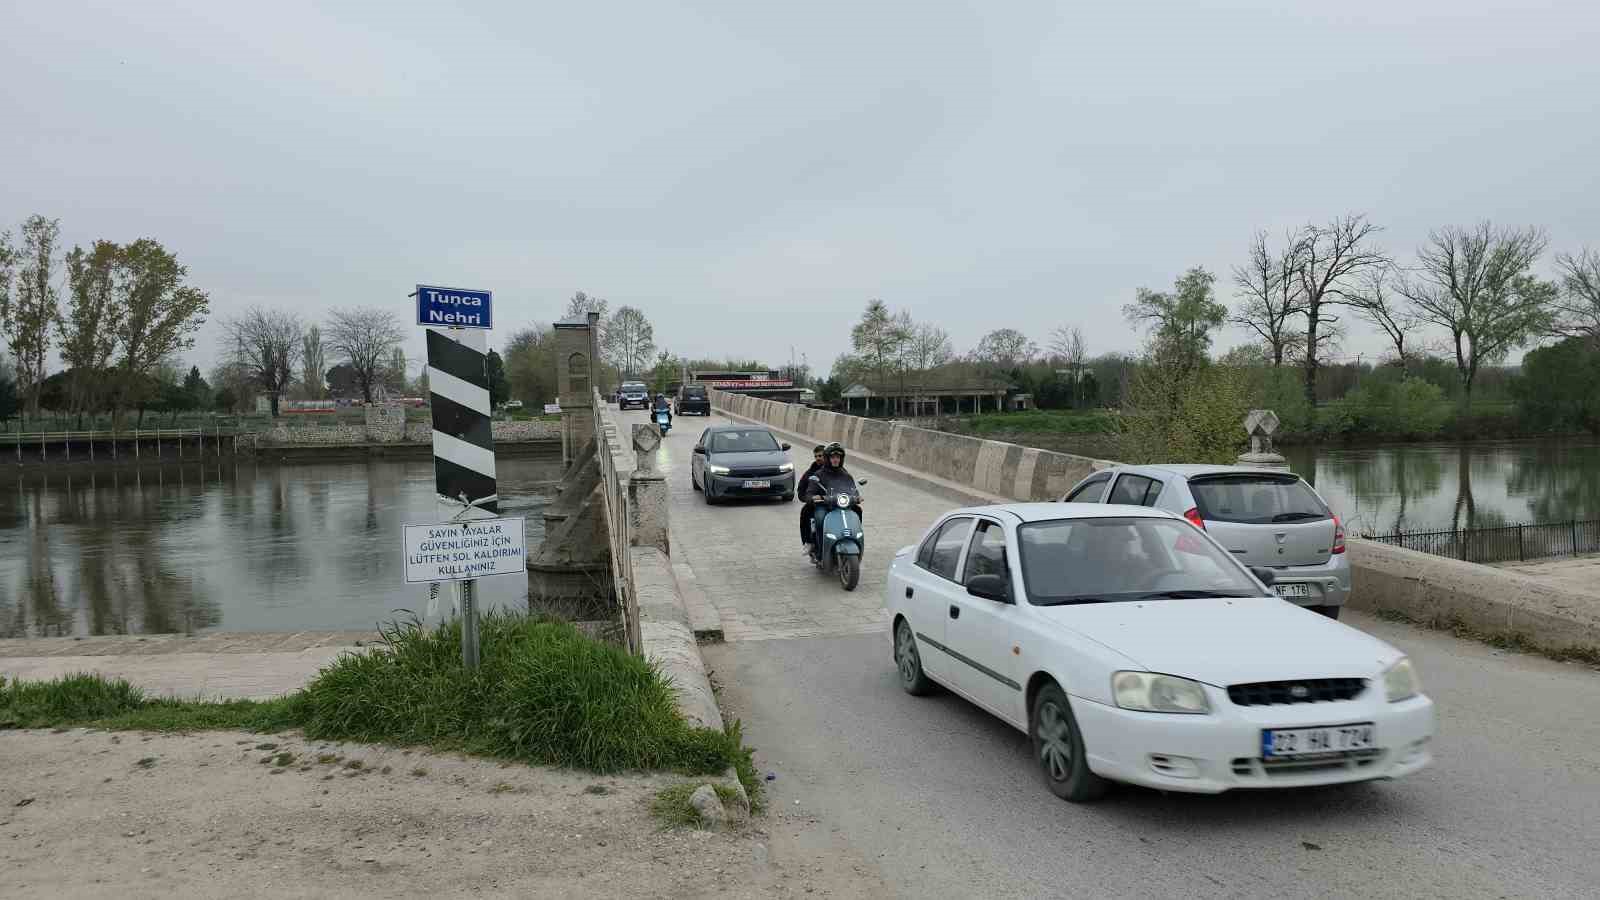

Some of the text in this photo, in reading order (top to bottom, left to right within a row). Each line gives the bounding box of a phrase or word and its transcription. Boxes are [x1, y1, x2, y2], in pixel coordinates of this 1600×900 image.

[427, 291, 481, 306] Tunca
[429, 310, 480, 324] Nehri
[428, 526, 501, 539] SAYIN YAYALAR
[410, 548, 520, 565] LÜTFEN SOL KALDIRIMI
[439, 561, 496, 575] KULLANINIZ
[1276, 733, 1297, 752] 22
